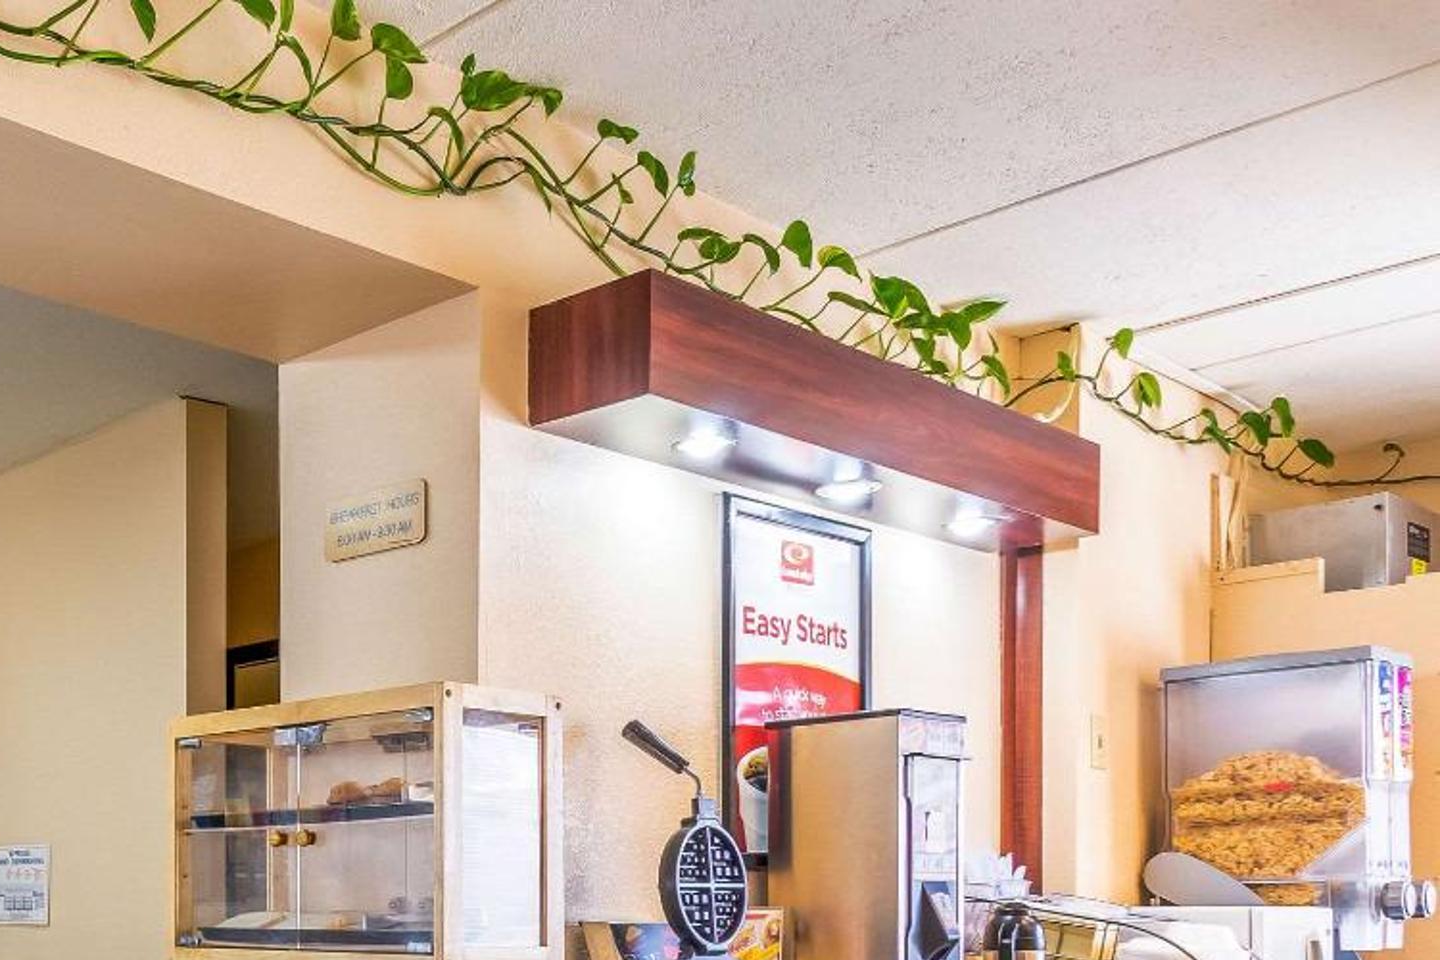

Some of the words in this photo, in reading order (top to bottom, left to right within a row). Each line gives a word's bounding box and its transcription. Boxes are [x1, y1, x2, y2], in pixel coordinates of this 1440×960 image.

[742, 605, 792, 646] Easy
[796, 613, 848, 650] Starts
[772, 686, 782, 702] A
